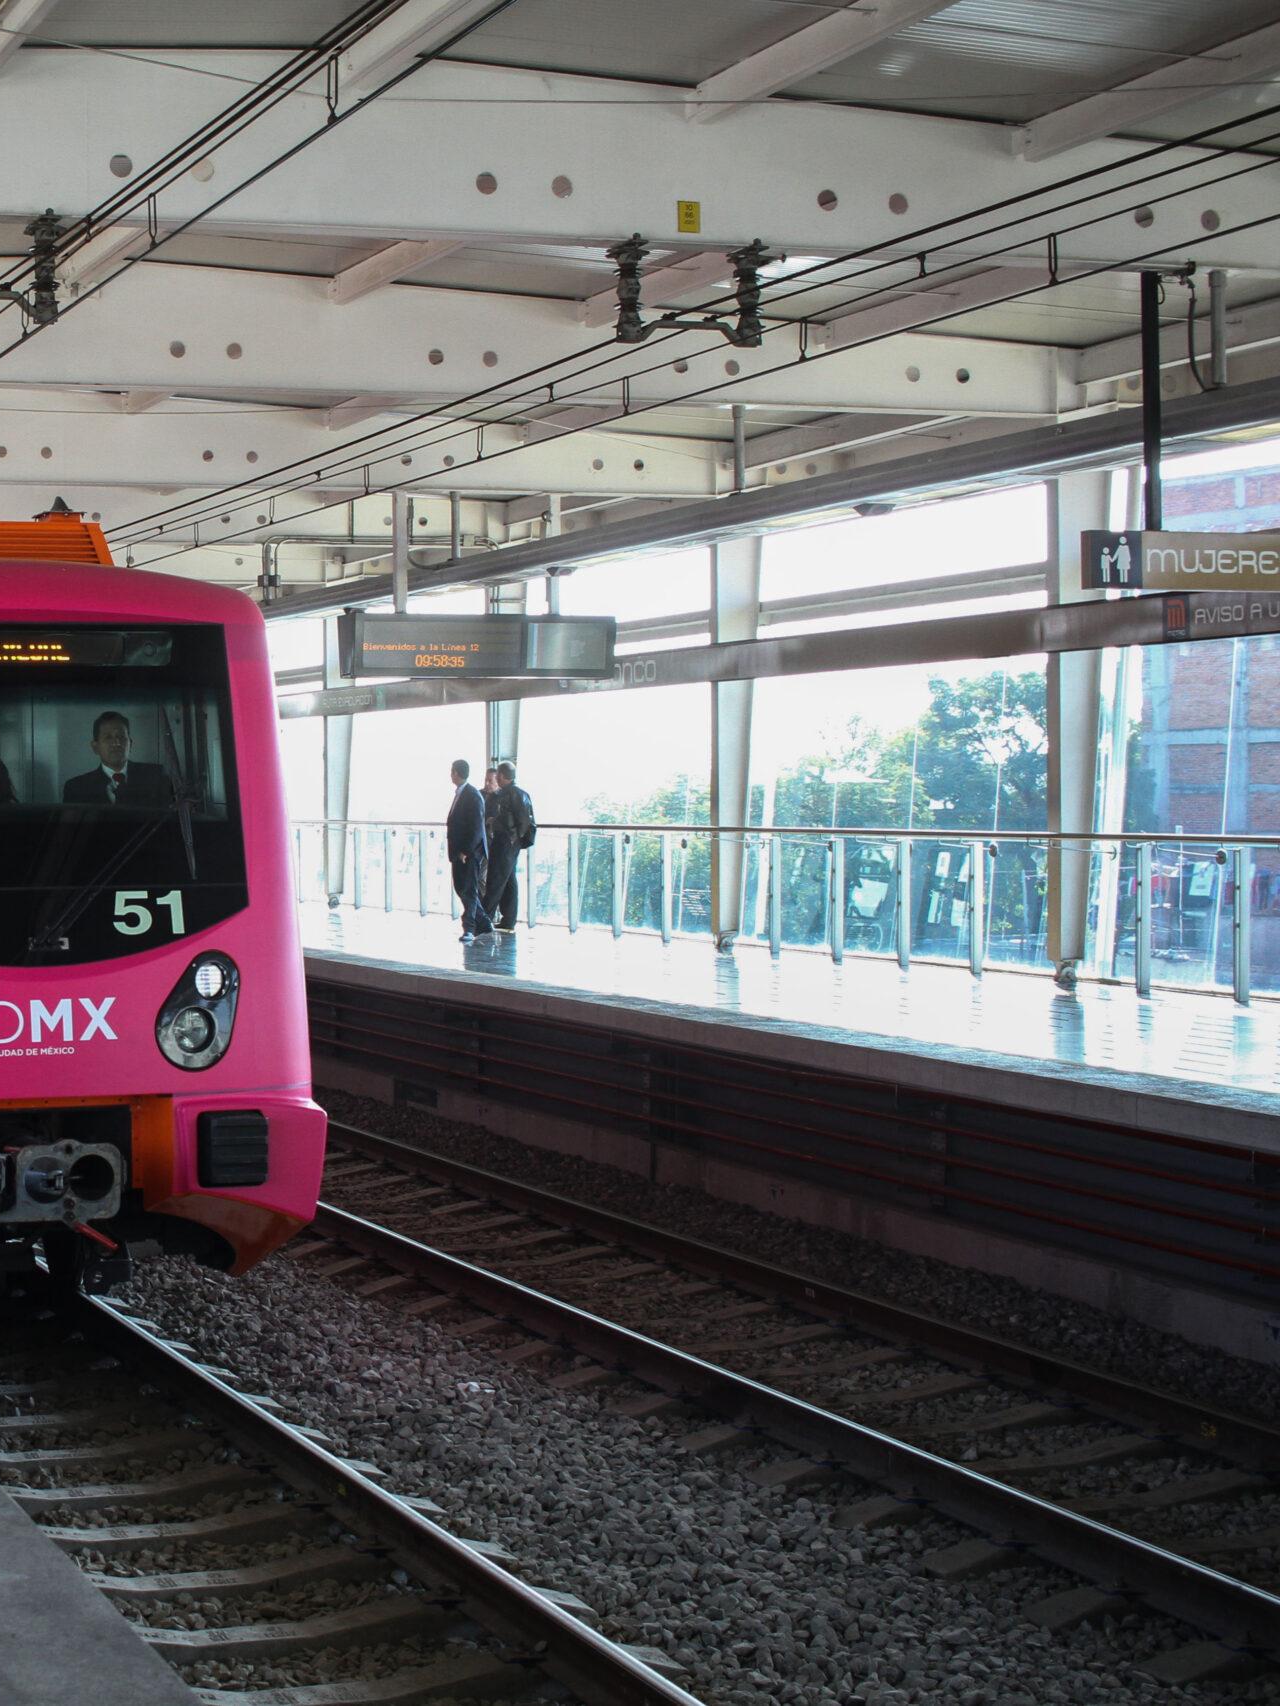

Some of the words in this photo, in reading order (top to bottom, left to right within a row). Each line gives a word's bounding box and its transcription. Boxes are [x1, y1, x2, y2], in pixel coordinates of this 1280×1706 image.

[1147, 548, 1280, 575] MUJERE
[1194, 604, 1245, 625] AVISO
[1249, 602, 1264, 621] A
[362, 642, 417, 652] Bienvenidos
[415, 654, 465, 668] 09:58:35
[111, 889, 186, 936] 51
[25, 1048, 39, 1057] DE
[40, 1046, 75, 1056] MÉXICO
